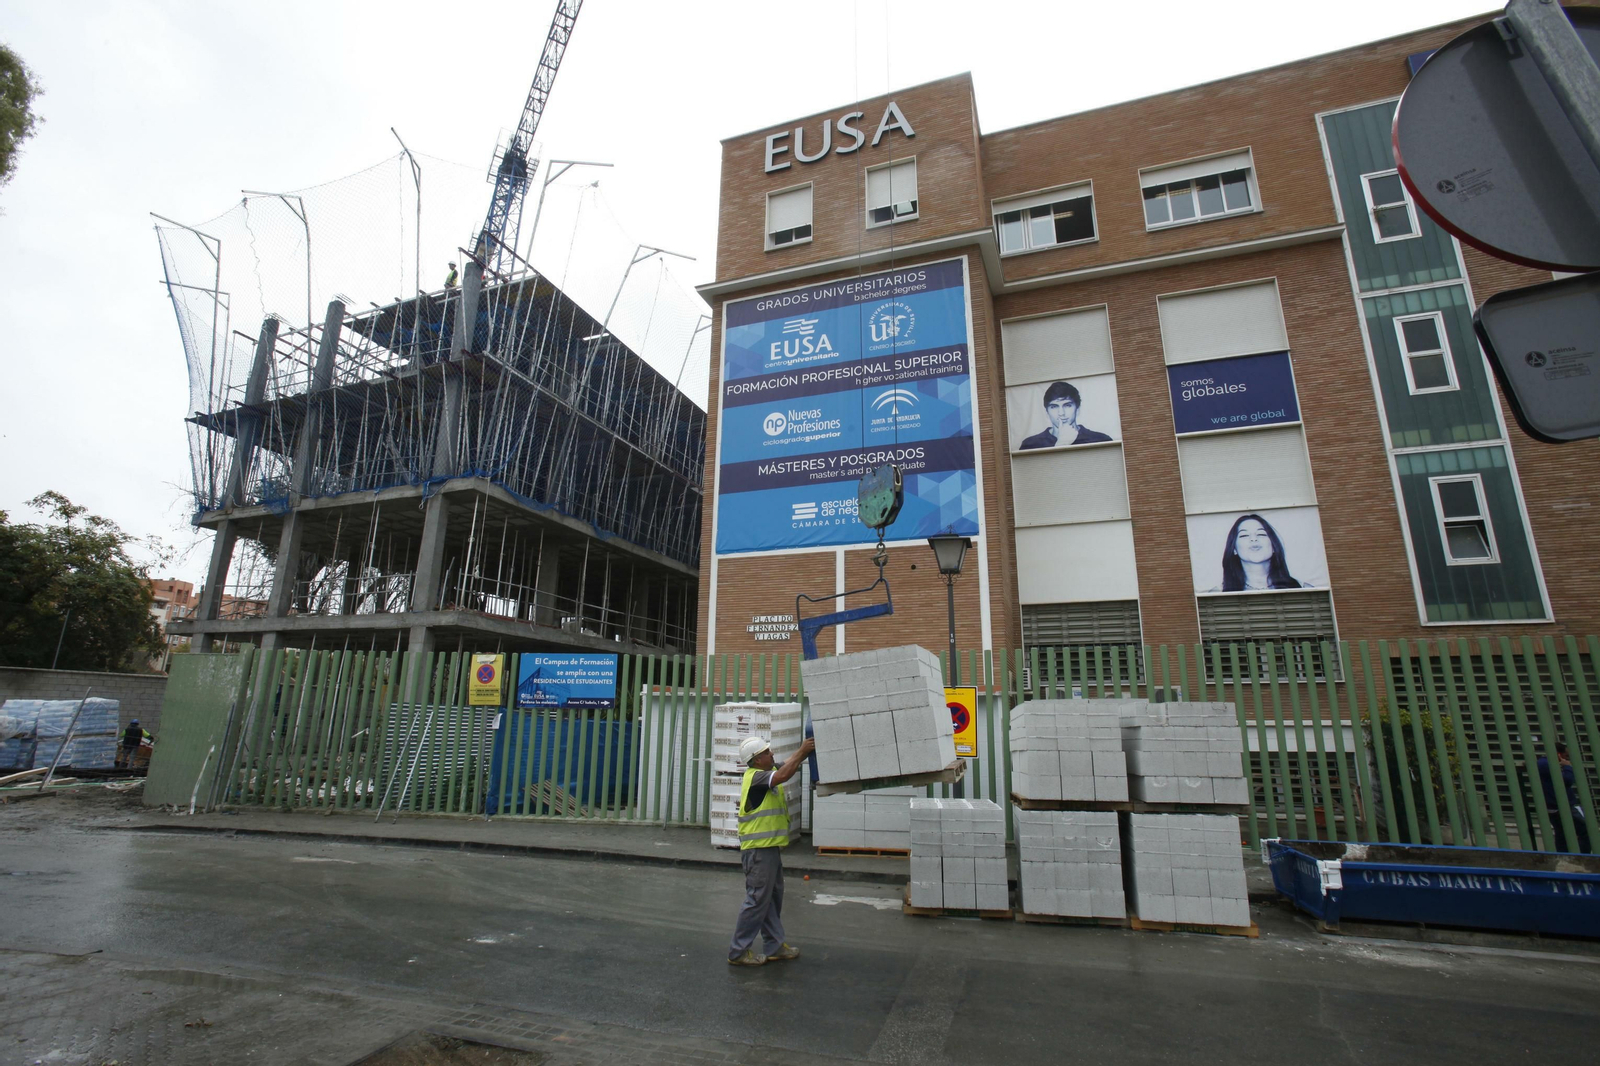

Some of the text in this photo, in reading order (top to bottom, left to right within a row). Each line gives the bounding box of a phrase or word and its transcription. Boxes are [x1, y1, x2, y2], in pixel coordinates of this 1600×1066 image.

[764, 101, 916, 174] EUSA
[756, 270, 927, 311] GRADOS UNIVERSITARIOS
[770, 333, 833, 360] EUSA
[869, 343, 890, 351] CENTRO
[764, 352, 840, 368] centrouniversitario
[726, 351, 962, 396] FORMACIÓN PROFESIONAL SUPERIOR
[855, 375, 882, 386] hgher
[930, 364, 963, 376] training
[1180, 377, 1214, 388] somos
[1181, 383, 1247, 401] globales
[788, 408, 822, 421] Nuevas
[887, 416, 894, 424] DE
[1211, 408, 1286, 424] we are global
[787, 419, 841, 435] Profesiones
[870, 425, 890, 433] CENTRO
[762, 431, 841, 446] ciclosgradosuperior
[758, 447, 925, 476] MÁSTERES Y POSGRADOS
[847, 467, 864, 477] and
[821, 507, 836, 517] de
[792, 519, 830, 529] CÁMARA
[753, 615, 793, 623] PLACIDO
[747, 624, 798, 632] FERNANDEZ
[535, 657, 614, 667] El Campus de Formación
[1362, 869, 1431, 887] CUBAS
[1438, 872, 1525, 894] MARTIN
